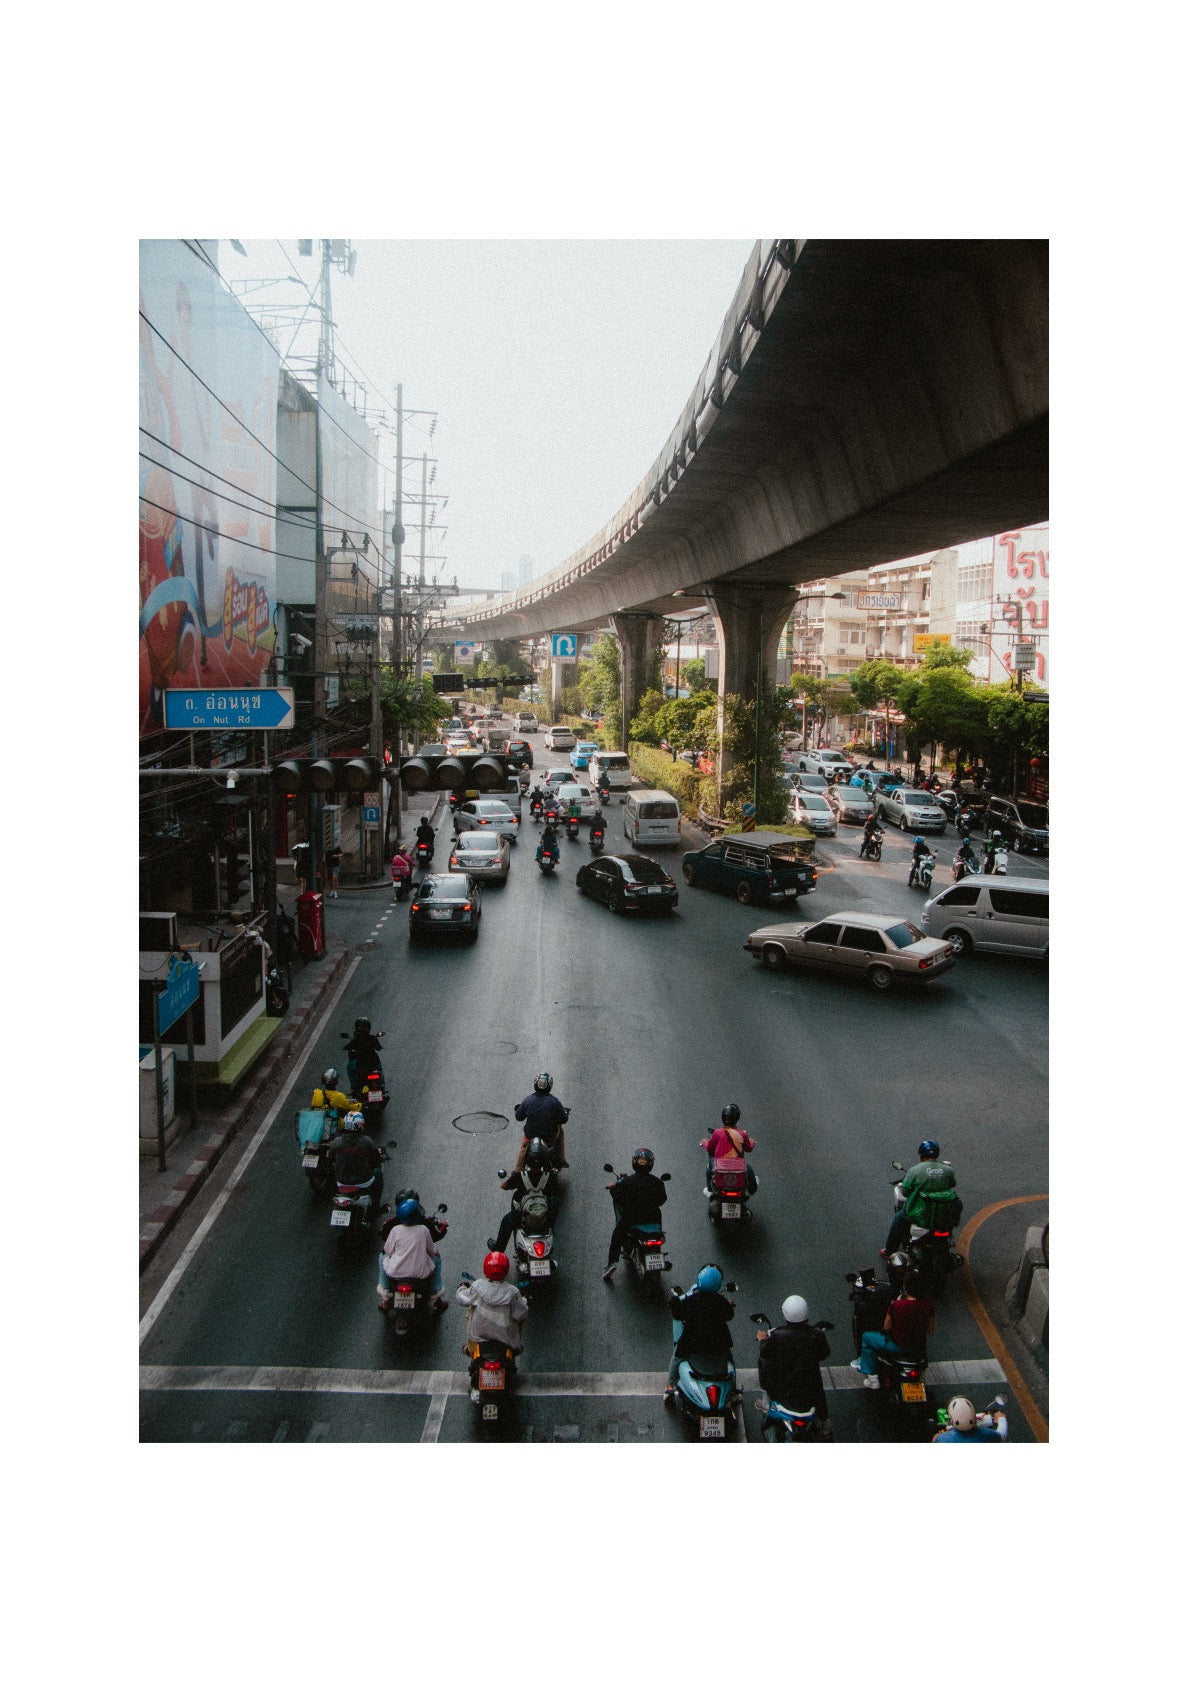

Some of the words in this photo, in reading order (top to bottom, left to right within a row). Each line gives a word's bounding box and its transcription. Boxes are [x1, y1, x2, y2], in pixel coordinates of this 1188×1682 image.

[185, 698, 198, 710] ถ.
[206, 693, 261, 714] อ่อนนุช
[192, 715, 205, 724] On
[213, 715, 229, 724] Nut
